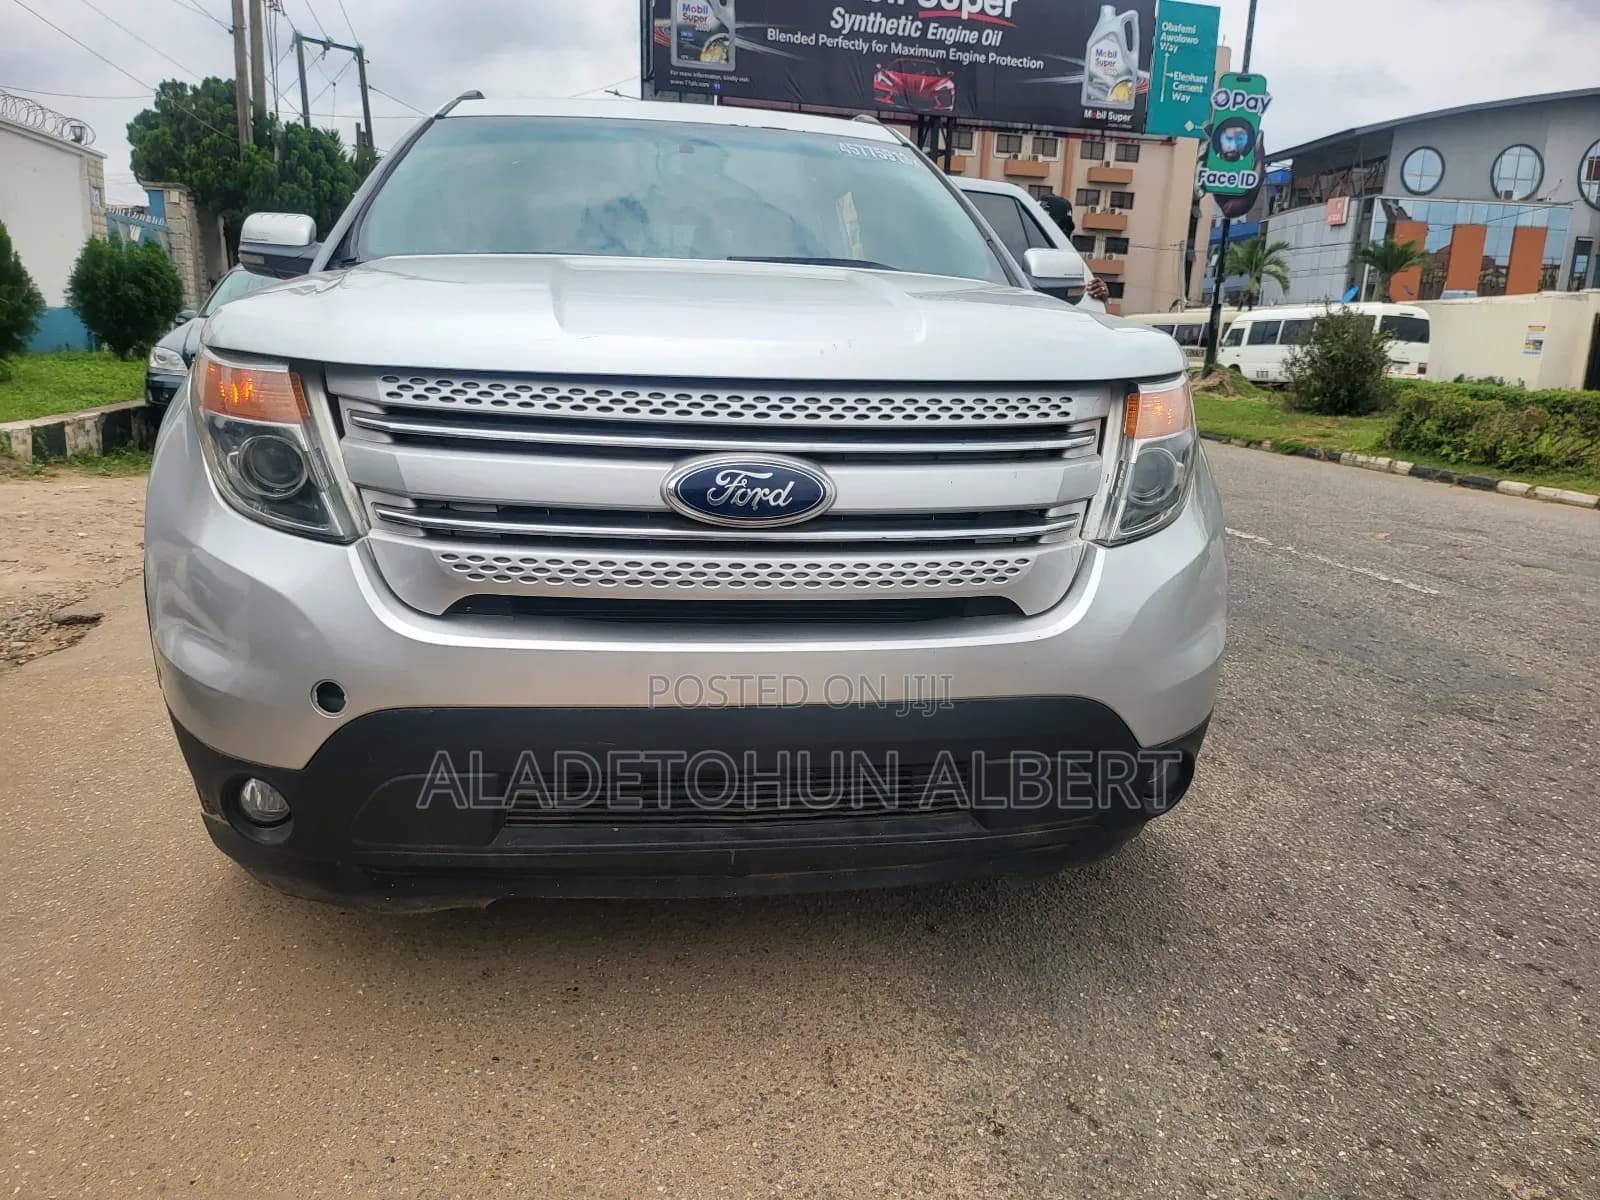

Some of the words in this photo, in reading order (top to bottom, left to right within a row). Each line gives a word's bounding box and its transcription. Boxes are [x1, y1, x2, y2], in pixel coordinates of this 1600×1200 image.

[683, 4, 708, 14] Mobil
[683, 13, 708, 24] Super
[830, 7, 922, 38] Synthetic
[927, 23, 978, 46] Engine
[981, 29, 1002, 47] Oil
[1162, 22, 1196, 34] Obafemi
[1161, 32, 1199, 45] Awolowo
[767, 28, 816, 46] Blended
[819, 34, 869, 54] Perfectly
[871, 40, 888, 53] for
[891, 43, 946, 59] Maximum
[949, 49, 986, 65] Engine
[989, 53, 1044, 70] Protection
[1096, 49, 1117, 58] Mobil
[1160, 42, 1178, 54] Way
[1174, 71, 1208, 84] Elephant
[1172, 81, 1203, 93] Cement
[1172, 91, 1191, 104] Way
[1213, 90, 1272, 114] OPay
[1083, 109, 1107, 120] Mobil
[1107, 111, 1132, 122] Super
[1198, 170, 1236, 186] Face
[1240, 172, 1257, 187] ID
[707, 470, 795, 511] Ford
